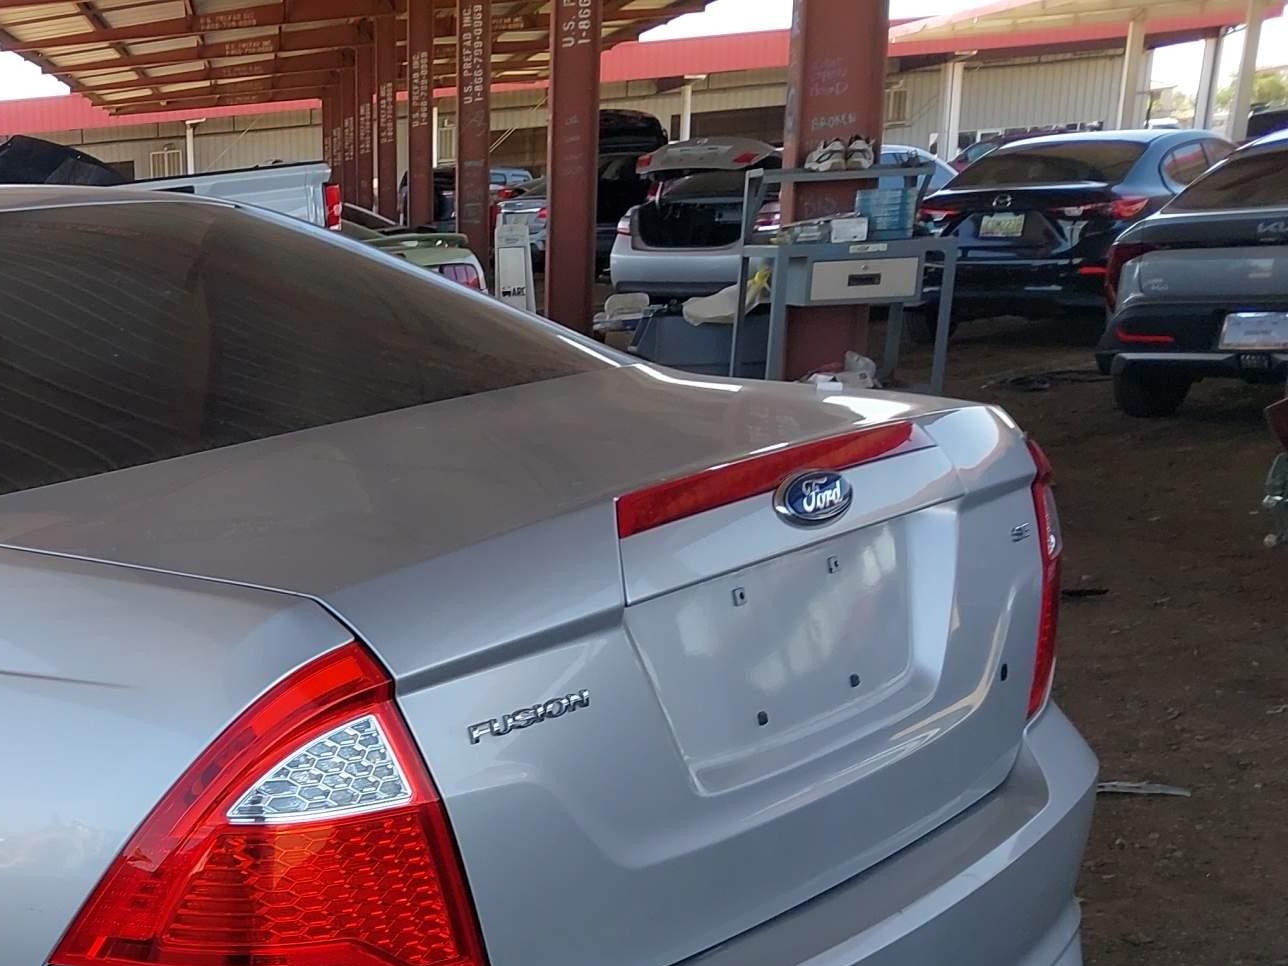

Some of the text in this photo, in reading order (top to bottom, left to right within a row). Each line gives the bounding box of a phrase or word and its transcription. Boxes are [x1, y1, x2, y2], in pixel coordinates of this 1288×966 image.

[562, 15, 576, 48] U.S.
[462, 31, 473, 77] PREFAB
[463, 82, 473, 105] U.S.
[802, 477, 843, 512] Ford
[467, 689, 590, 745] FUSION
